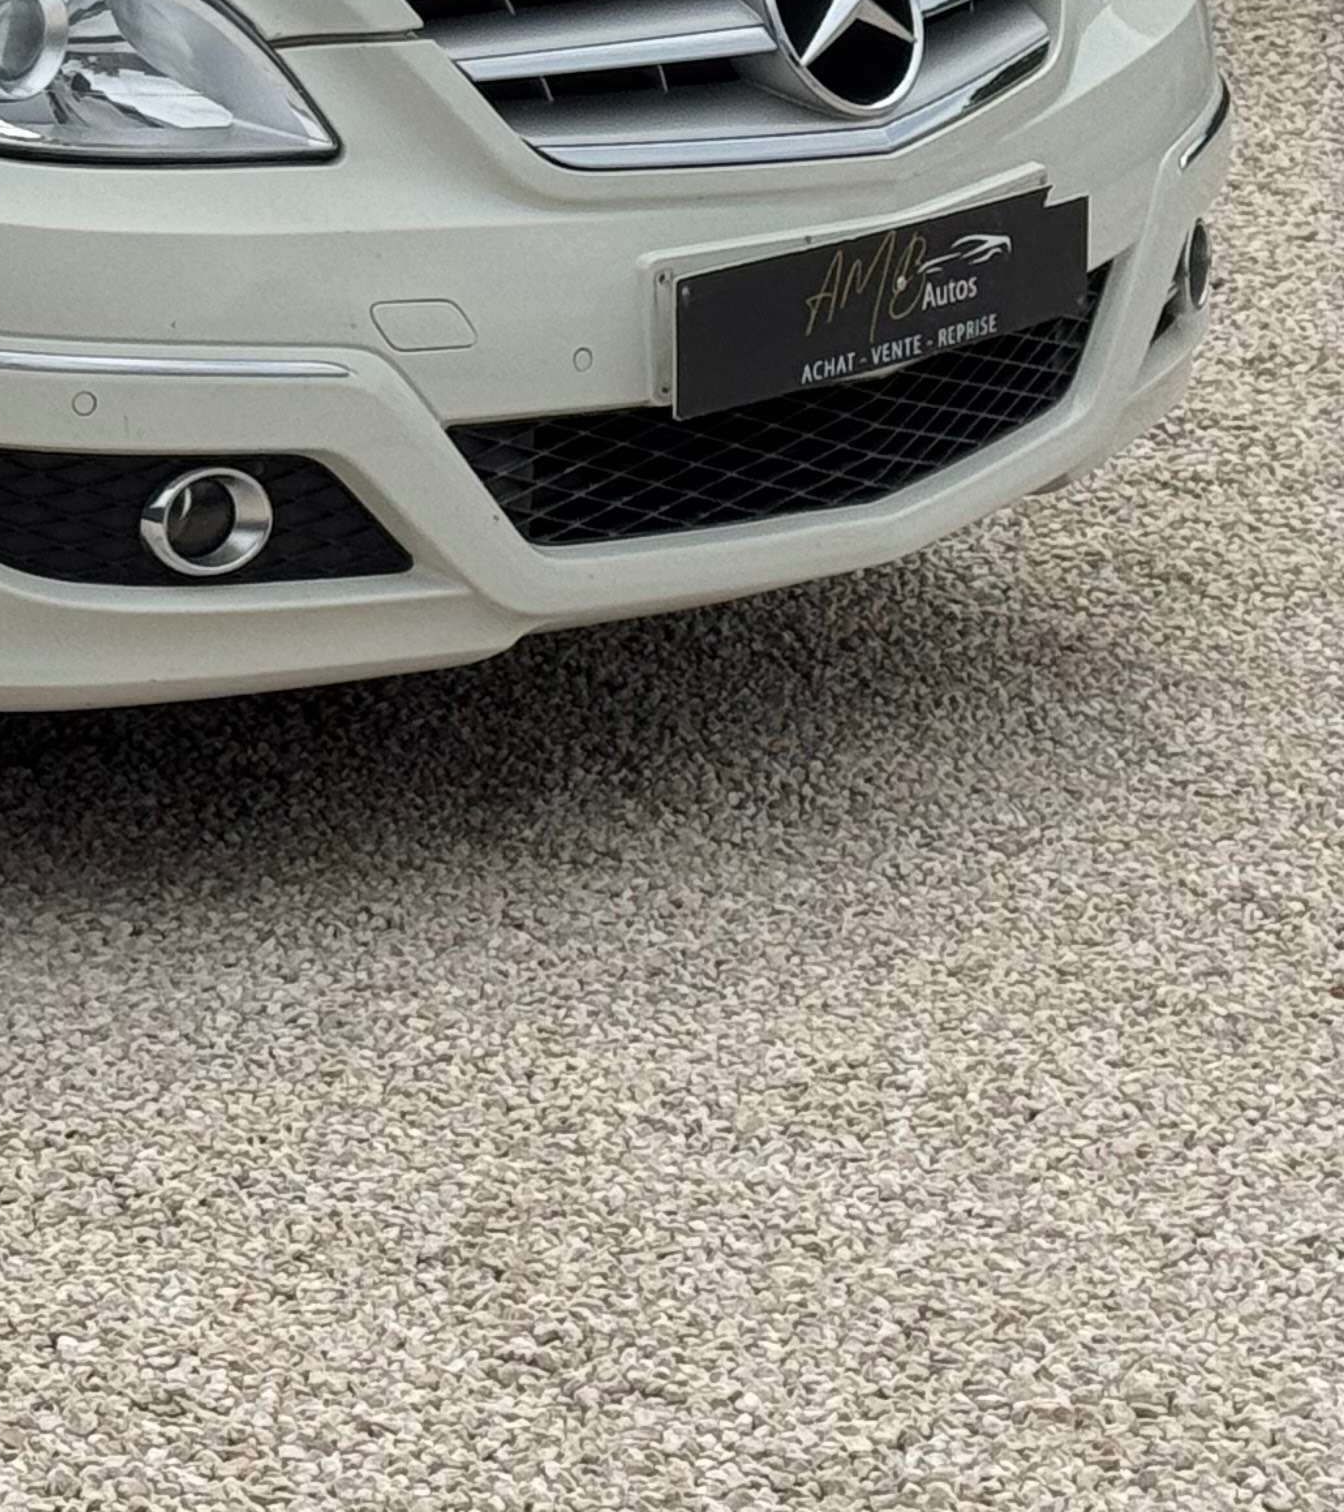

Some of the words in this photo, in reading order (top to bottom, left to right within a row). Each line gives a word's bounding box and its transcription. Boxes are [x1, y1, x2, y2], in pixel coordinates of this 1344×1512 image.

[805, 230, 928, 343] AMB
[921, 276, 978, 311] Autos
[801, 352, 856, 384] ACHAT
[870, 333, 923, 366] VENTE
[937, 313, 998, 347] REPRISE
